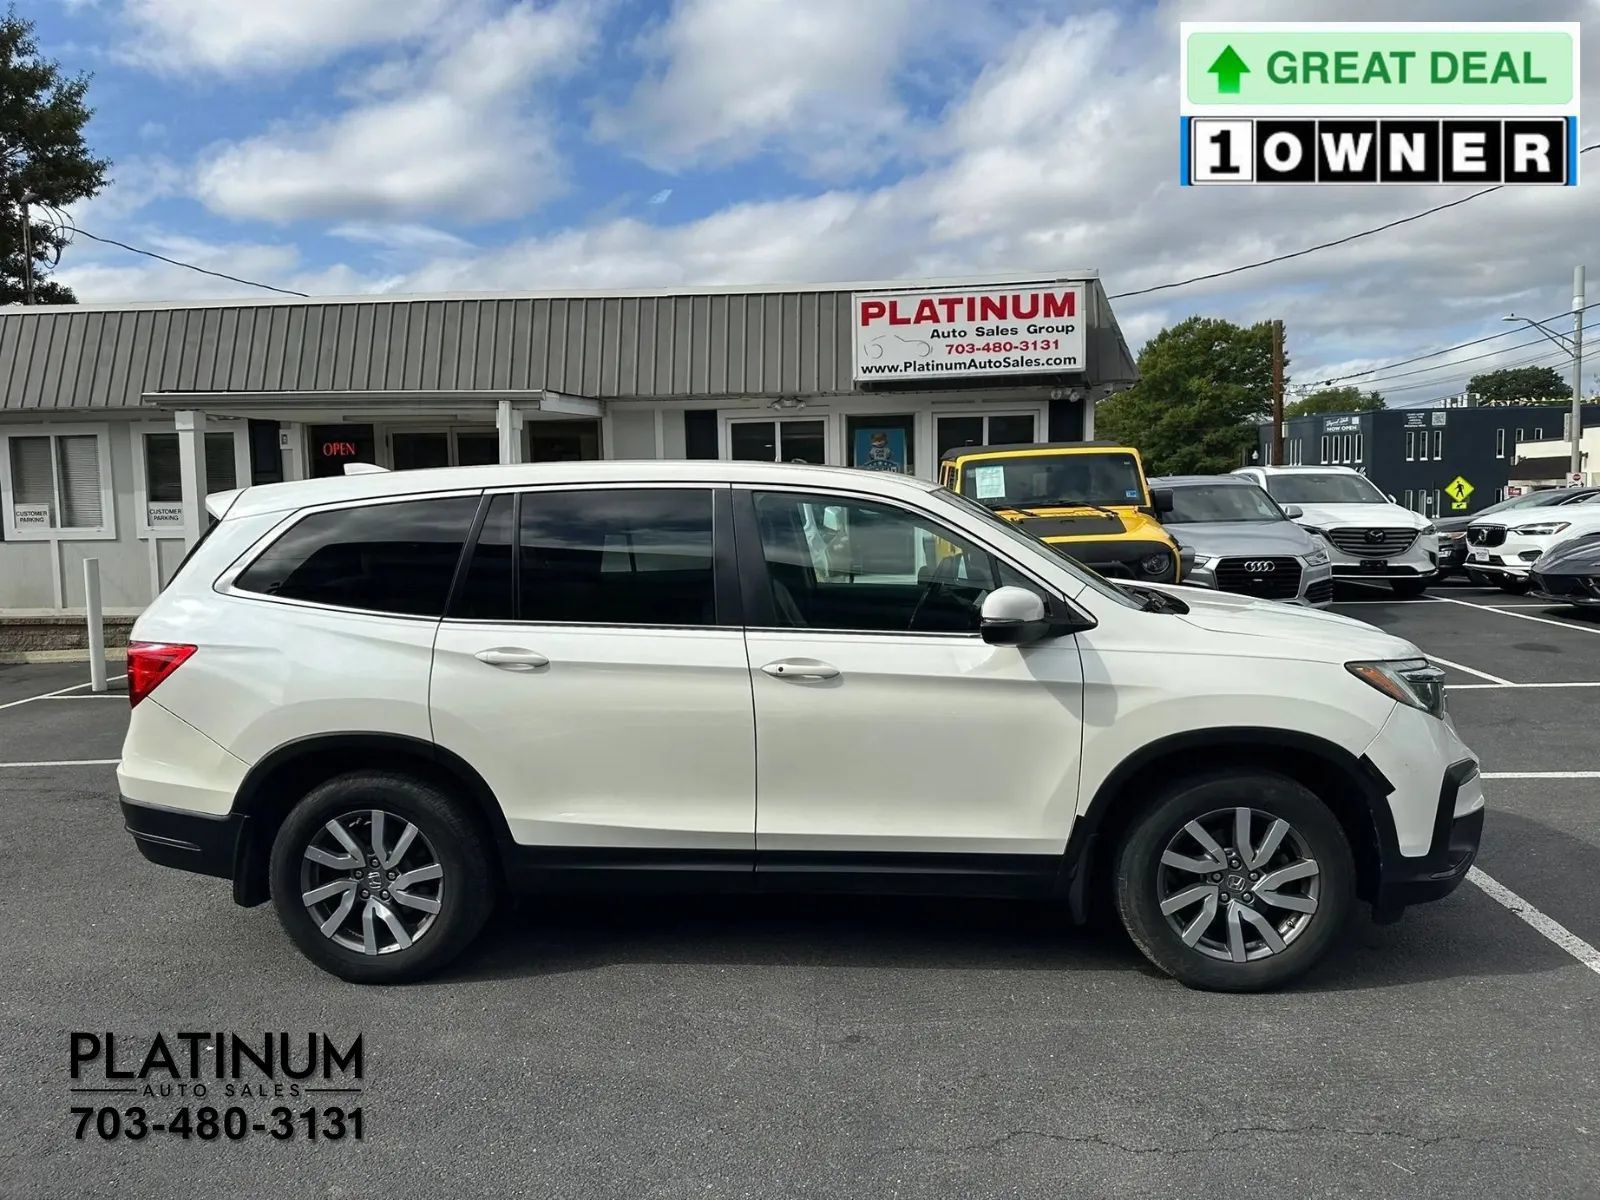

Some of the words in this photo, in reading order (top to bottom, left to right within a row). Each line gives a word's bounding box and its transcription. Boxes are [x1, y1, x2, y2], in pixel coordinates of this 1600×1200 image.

[861, 291, 1076, 326] PLATINUM
[930, 328, 967, 339] Auto
[975, 325, 1018, 337] Sales
[1026, 323, 1075, 335] Group
[945, 339, 1060, 355] 703-480-3131
[861, 355, 1077, 375] www.PlatinumAutoSales.com
[323, 442, 356, 456] OPEN
